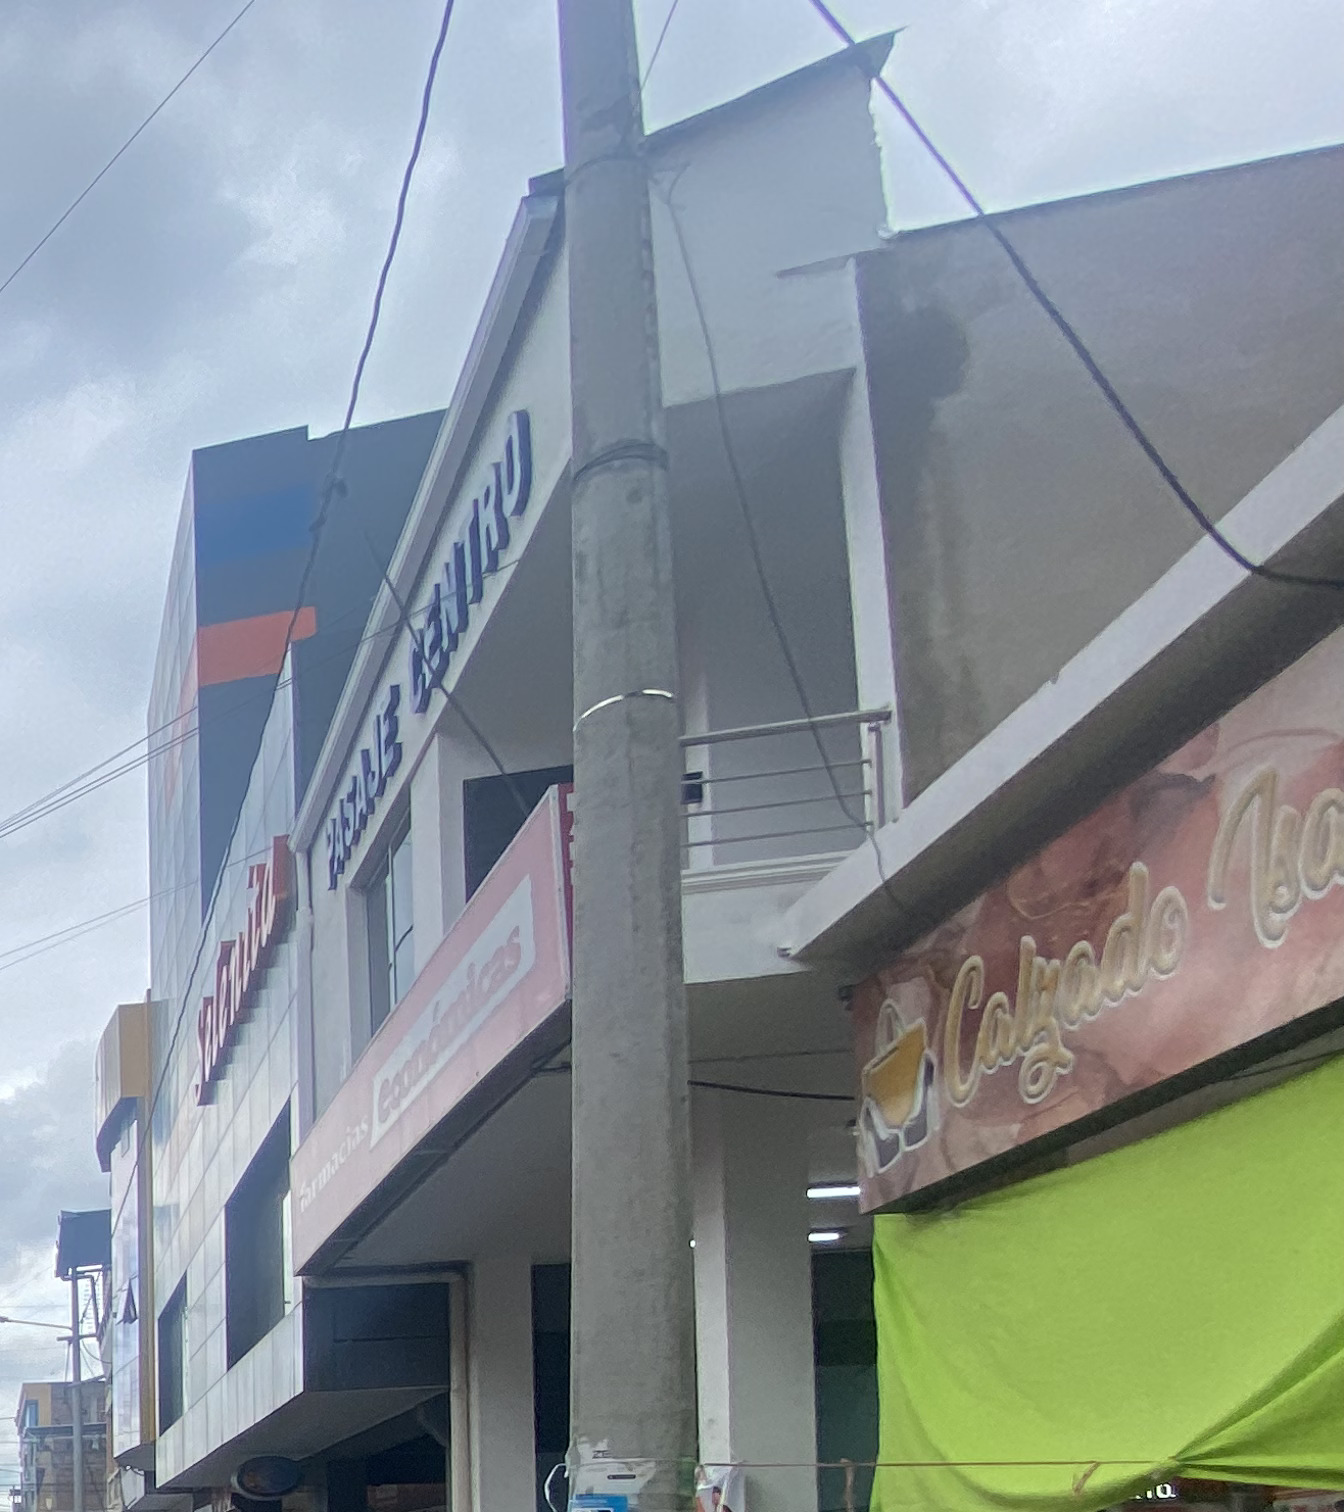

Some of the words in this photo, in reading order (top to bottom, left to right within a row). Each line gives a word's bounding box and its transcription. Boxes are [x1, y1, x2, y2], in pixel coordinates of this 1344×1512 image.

[326, 684, 402, 890] PASAJE
[944, 861, 1188, 1108] Calzado
[299, 1115, 369, 1213] farmacias
